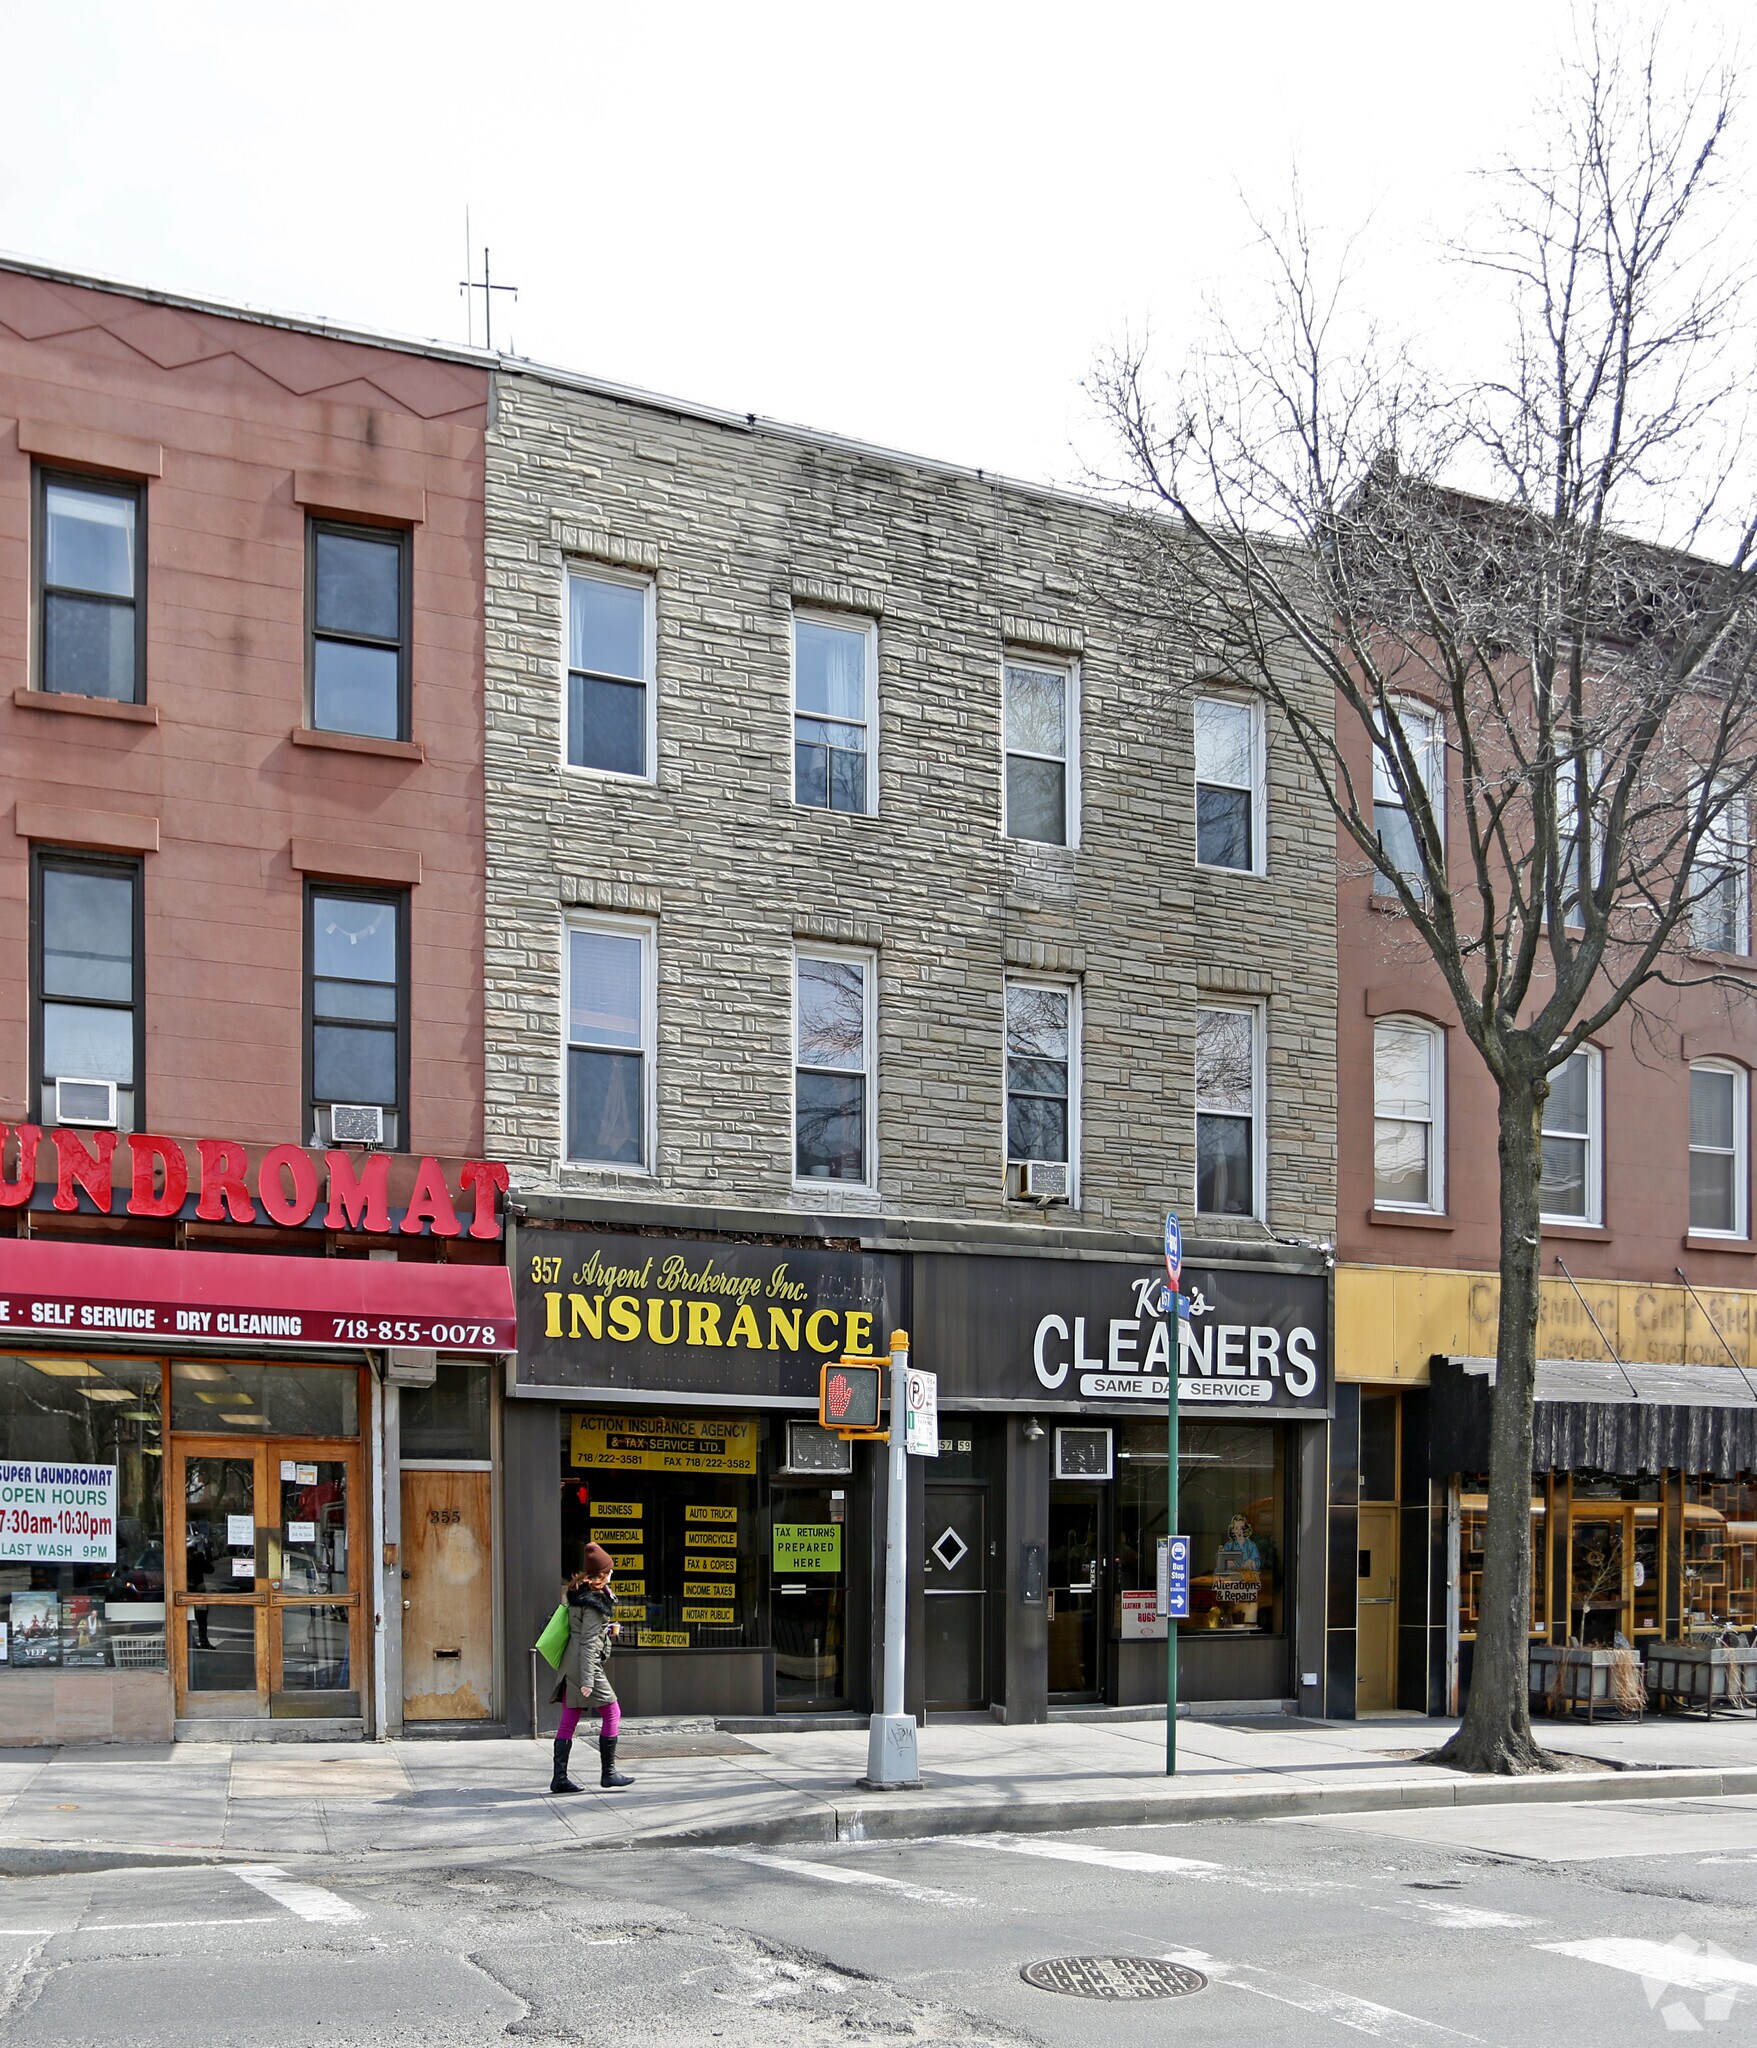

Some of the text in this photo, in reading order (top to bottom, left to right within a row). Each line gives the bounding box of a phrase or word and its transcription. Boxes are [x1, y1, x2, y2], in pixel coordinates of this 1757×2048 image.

[531, 1250, 809, 1305] 357 Argent Brokerage Inc.
[31, 1302, 75, 1324] SELF
[80, 1305, 156, 1329] SERVICE
[176, 1310, 212, 1331] DRY
[216, 1313, 302, 1336] CLEANING
[543, 1292, 874, 1354] INSURANCE
[332, 1318, 496, 1345] 718-855-0078
[1033, 1314, 1317, 1397] CLEANERS
[1094, 1378, 1143, 1393] SAME
[1190, 1383, 1260, 1396] SERVICE
[580, 1417, 748, 1438] ACTION INSURANCE AGENCY
[611, 1436, 721, 1452] & TAX SERVICE LTD.
[958, 1441, 970, 1450] 59
[577, 1453, 642, 1464] 718/222-3581
[664, 1457, 751, 1469] FAX 718/222-3582
[35, 1466, 113, 1486] LAUNDROMAT
[2, 1487, 107, 1506] OPEN HOURS
[597, 1504, 633, 1515] BUSINESS
[689, 1509, 733, 1519] AUTO TRUCK
[430, 1510, 461, 1524] 355
[593, 1530, 640, 1541] COMMERCIAL
[775, 1527, 791, 1537] TAX
[688, 1534, 734, 1544] MOTORCYCLE
[1, 1543, 107, 1557] LAST WASH 9PM
[777, 1542, 834, 1552] PREPARED
[621, 1557, 637, 1567] APT.
[687, 1559, 734, 1570] FAX & COPIES
[793, 1558, 821, 1567] HERE
[1172, 1562, 1184, 1571] Bus
[1171, 1572, 1185, 1580] Stop
[614, 1582, 640, 1592] HEALTH
[686, 1585, 733, 1595] INCOME TAXES
[1212, 1580, 1261, 1590] Alterations
[1216, 1590, 1257, 1603] & Repairs
[618, 1608, 643, 1618] MEDICAL
[686, 1609, 731, 1620] NOTARY PUBLIC
[639, 1633, 687, 1645] HOSPITALIZATION
